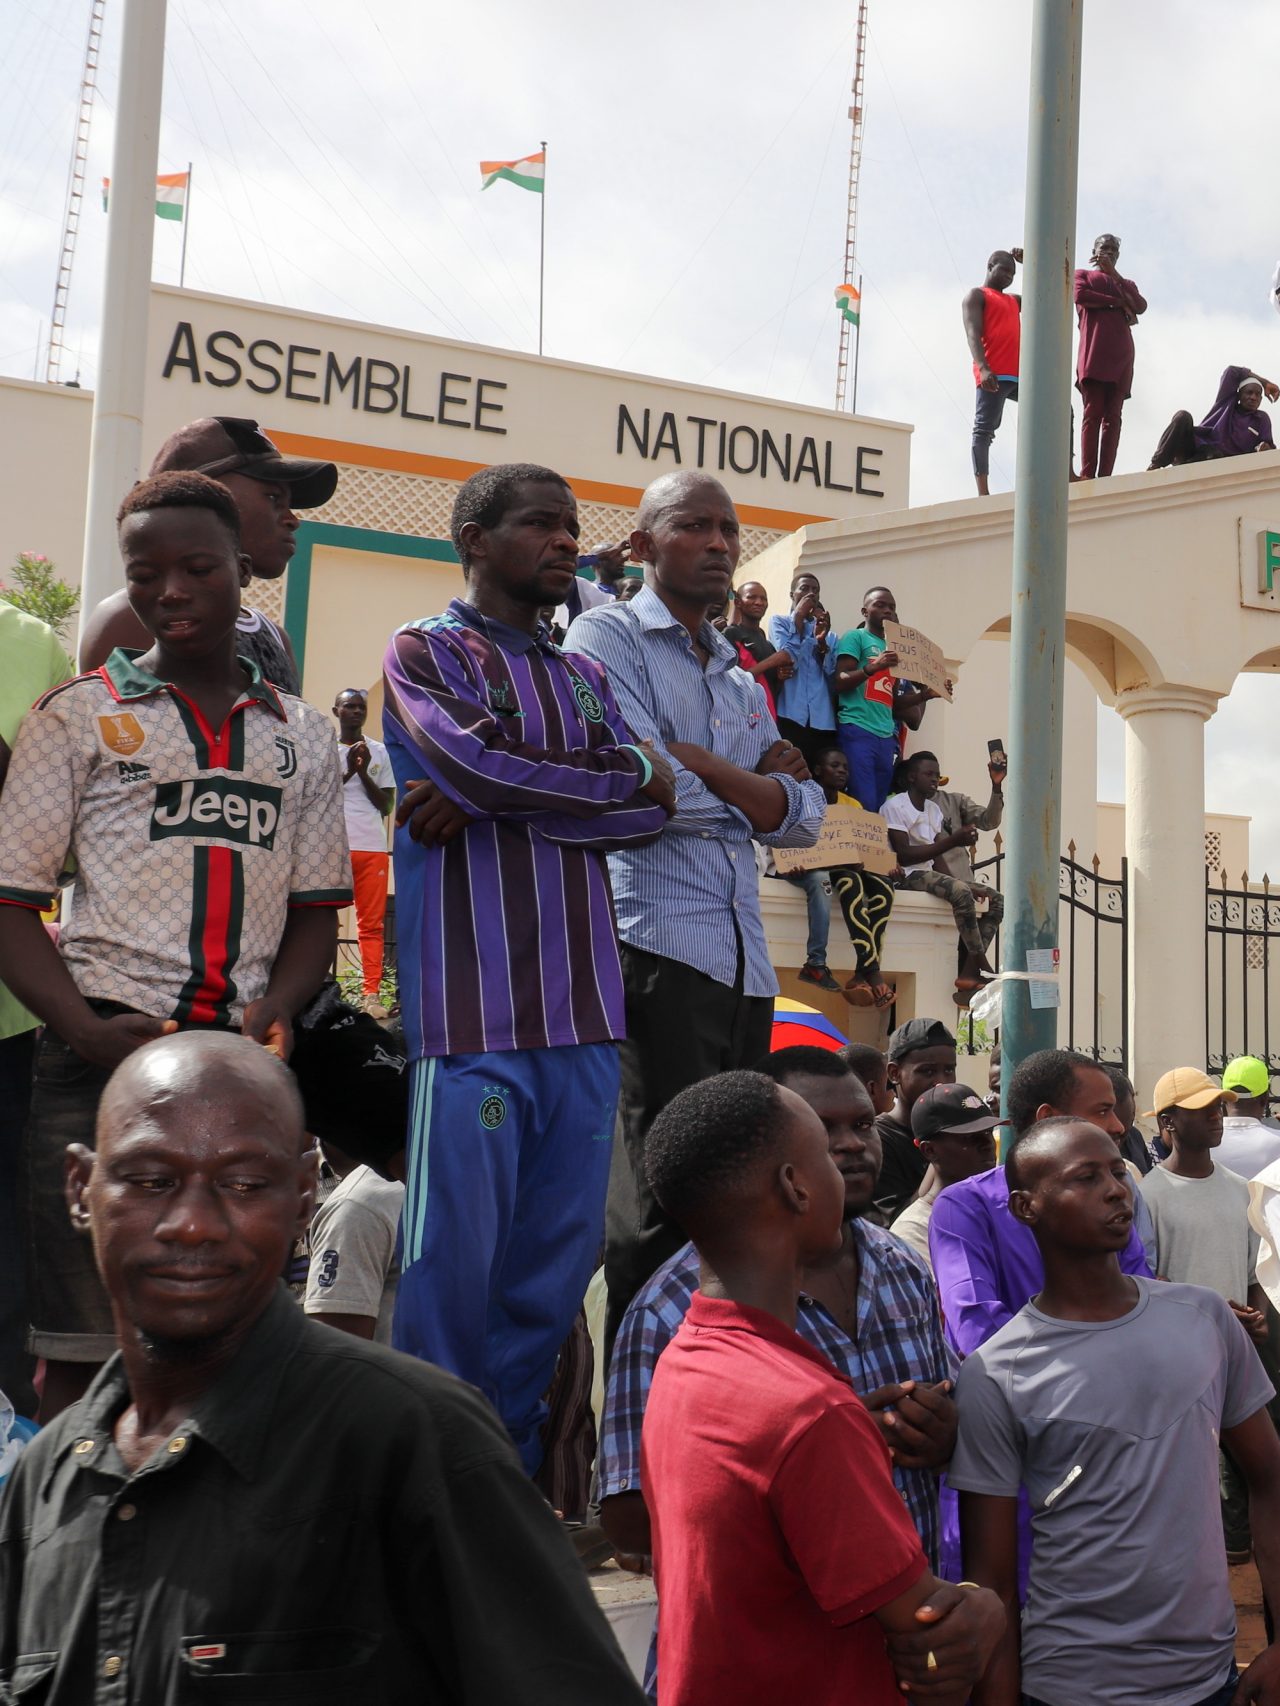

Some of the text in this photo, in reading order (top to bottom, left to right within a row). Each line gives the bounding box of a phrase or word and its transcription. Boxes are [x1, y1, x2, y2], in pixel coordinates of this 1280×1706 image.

[162, 321, 885, 498] ASSEMBLEE NATIONALE
[154, 781, 278, 843] Jeep
[318, 1250, 339, 1287] 3
